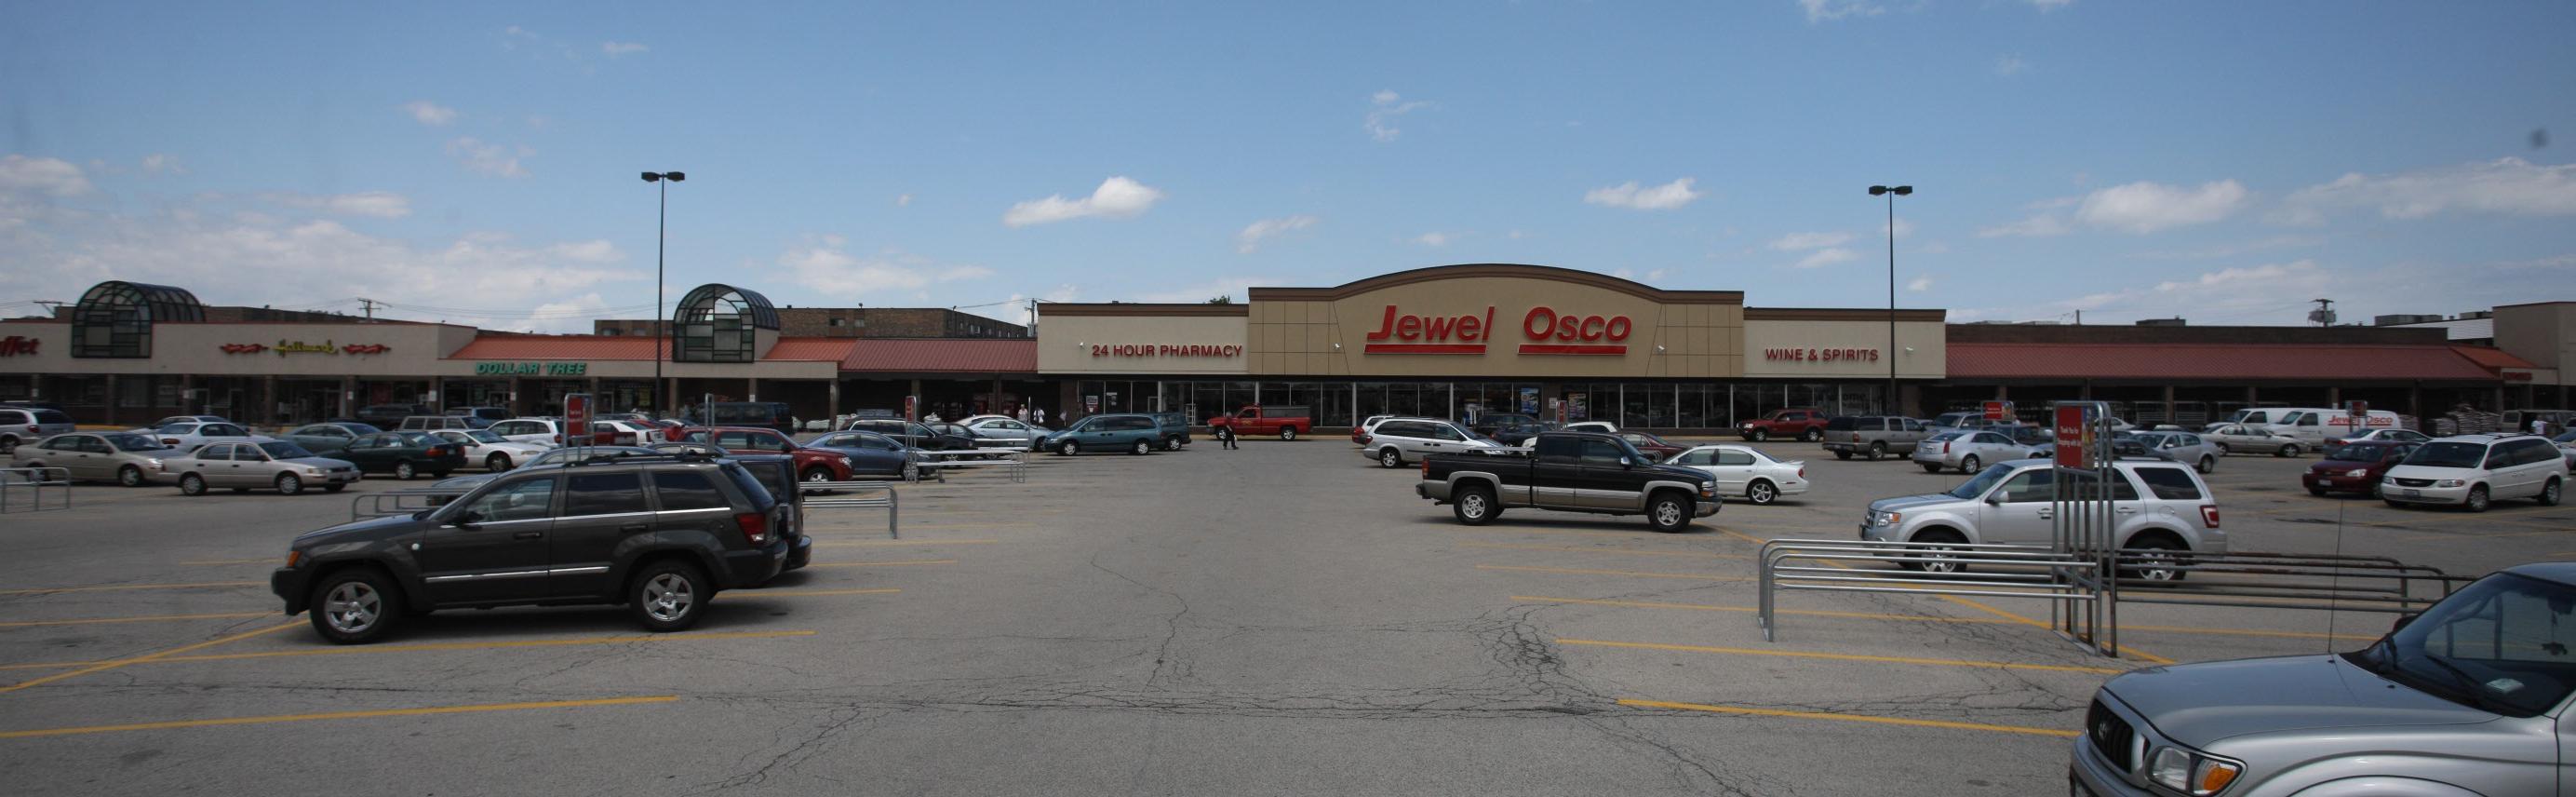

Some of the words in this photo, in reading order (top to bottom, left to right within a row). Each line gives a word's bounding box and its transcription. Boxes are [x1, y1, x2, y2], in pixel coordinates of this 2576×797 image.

[1367, 305, 1495, 342] Jewel
[1523, 306, 1632, 342] Osco
[1092, 344, 1108, 358] 24
[1113, 344, 1155, 358] HOUR
[1160, 344, 1242, 358] PHARMACY
[1765, 348, 1804, 361] WINE
[1808, 348, 1819, 361] &
[1822, 349, 1879, 361] SPIRITS
[476, 362, 540, 375] DOLLAR
[546, 362, 588, 375] TREE
